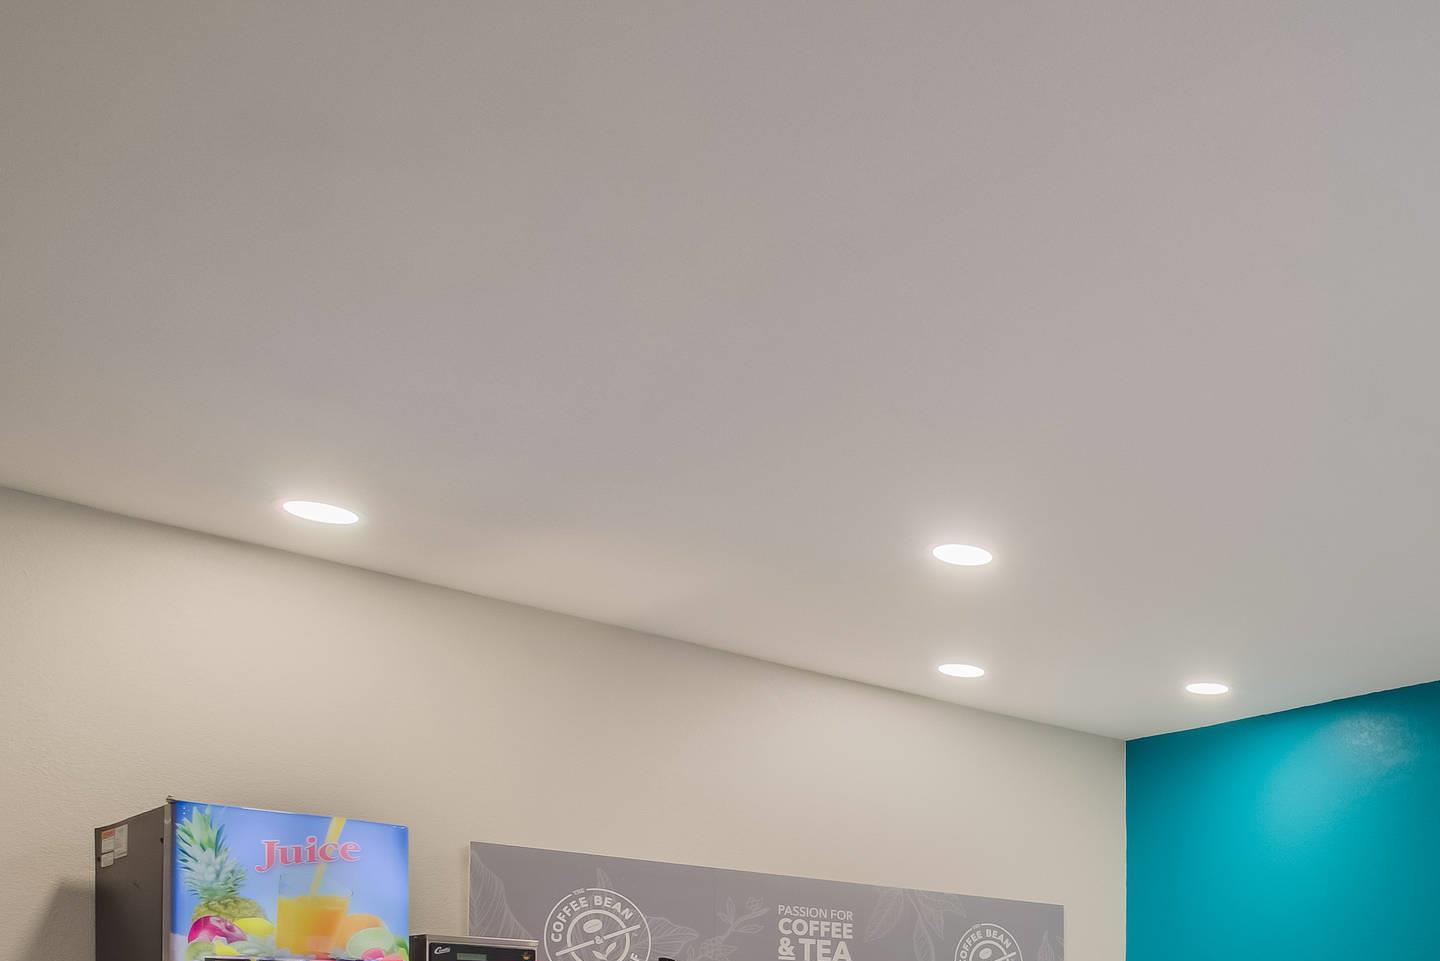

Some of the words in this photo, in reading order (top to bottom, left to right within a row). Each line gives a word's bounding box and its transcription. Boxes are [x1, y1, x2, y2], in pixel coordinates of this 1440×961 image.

[255, 835, 361, 872] Juice
[551, 896, 589, 942] COFFEE
[594, 895, 633, 920] BEAN
[778, 904, 827, 918] PASSION
[831, 909, 853, 921] FOR
[778, 917, 853, 939] COFFEE
[595, 935, 603, 945] &
[778, 936, 795, 957] &
[986, 929, 1012, 949] BEAN
